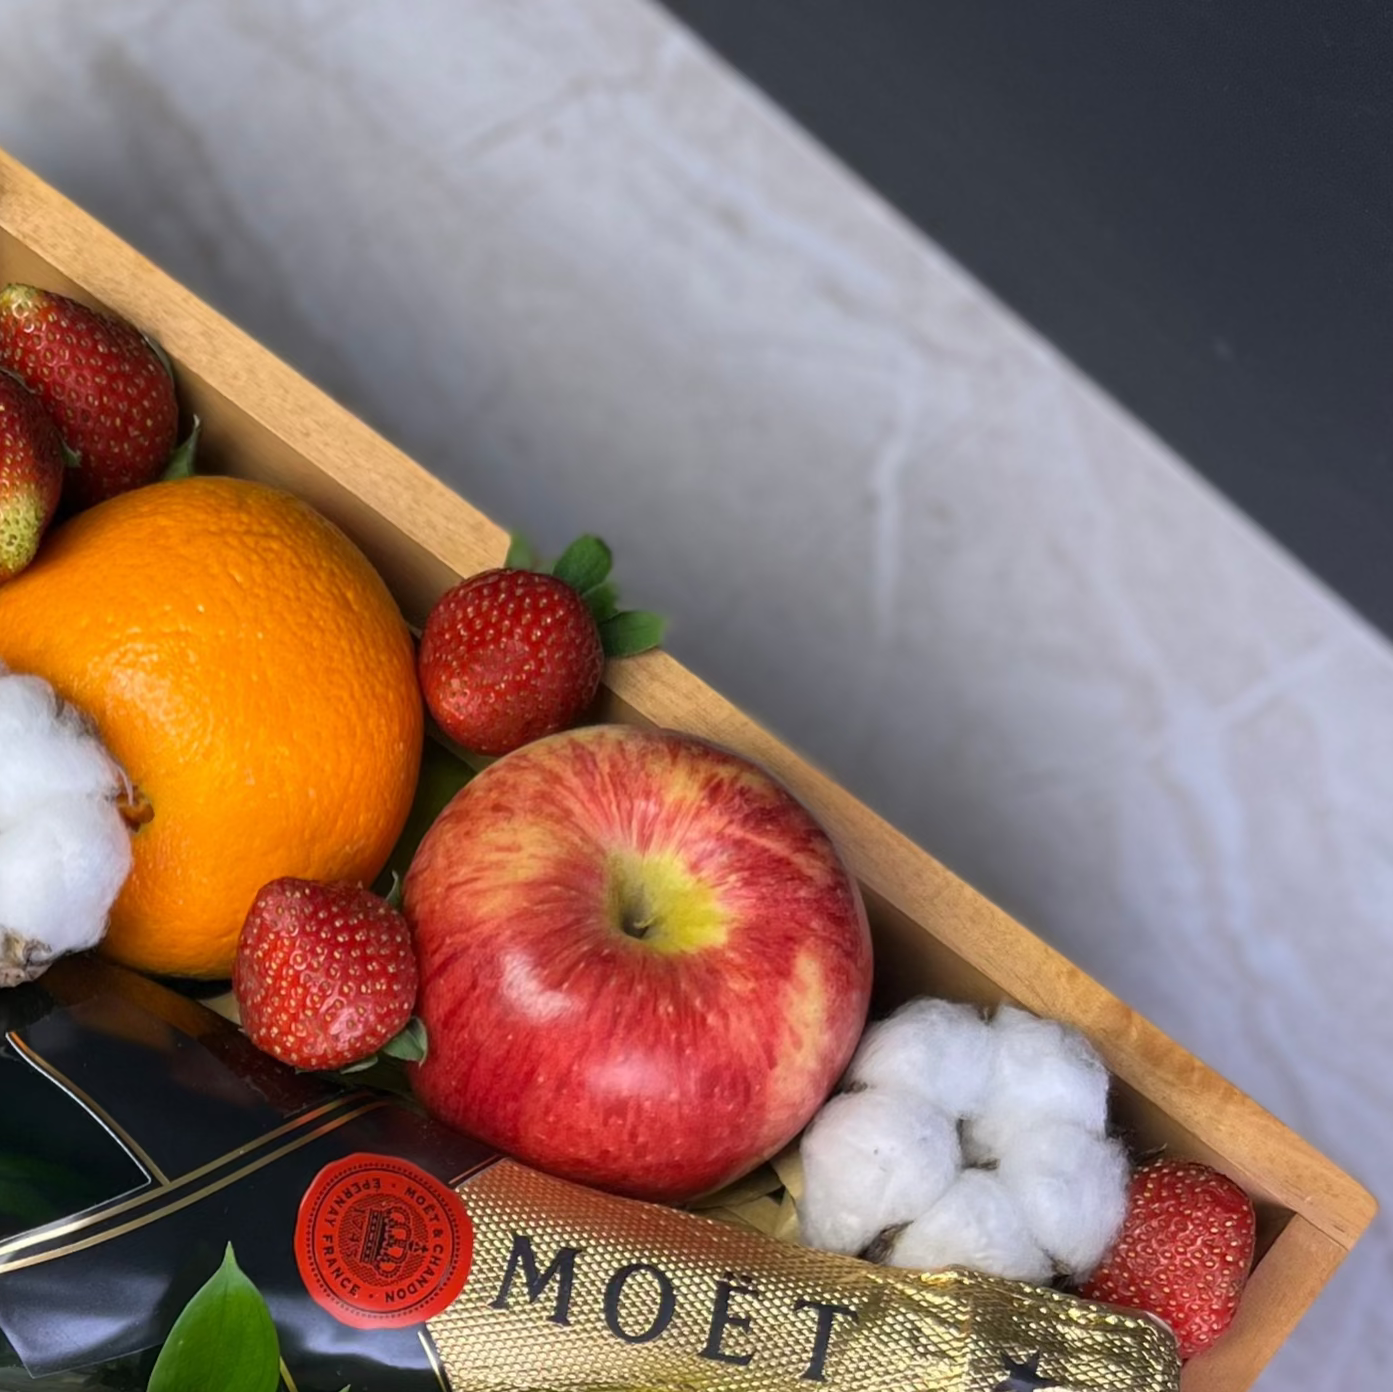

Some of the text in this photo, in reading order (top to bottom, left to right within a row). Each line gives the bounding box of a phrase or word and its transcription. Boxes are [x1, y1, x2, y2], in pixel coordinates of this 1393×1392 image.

[322, 1178, 381, 1297] ÉPERNAY FRANCE
[384, 1186, 444, 1303] MOËT & CHANDON
[489, 1233, 859, 1384] MOËT
